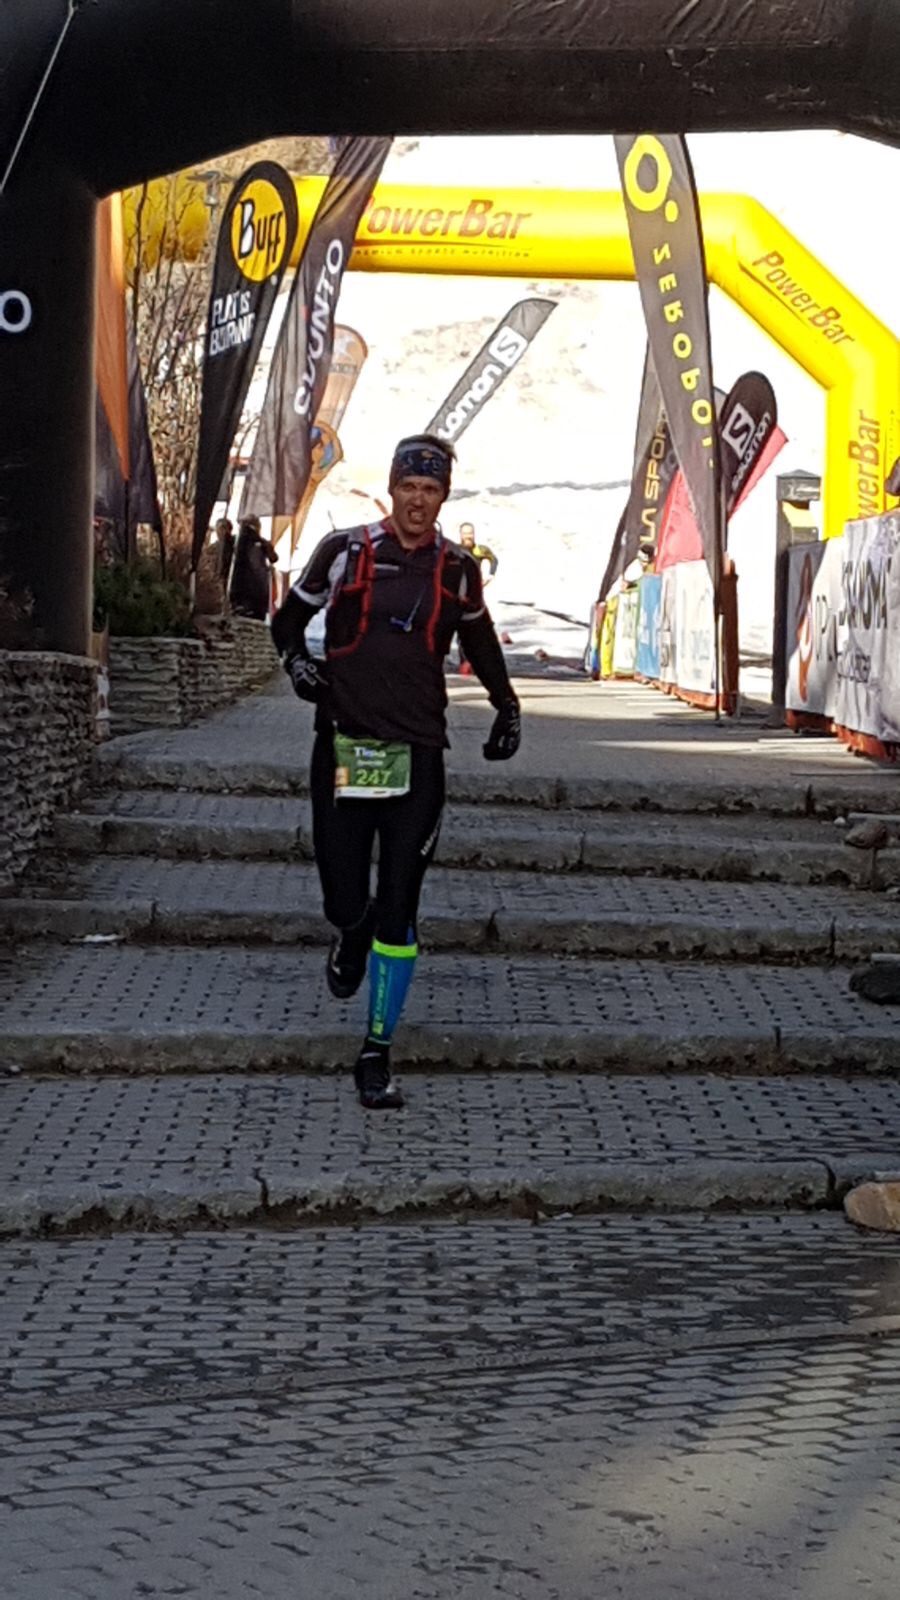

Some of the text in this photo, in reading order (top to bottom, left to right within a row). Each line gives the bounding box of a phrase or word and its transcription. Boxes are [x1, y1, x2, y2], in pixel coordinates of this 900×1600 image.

[366, 196, 533, 240] owerBar
[751, 249, 855, 346] PowerBar
[847, 408, 881, 520] werBar
[355, 769, 391, 785] 247
